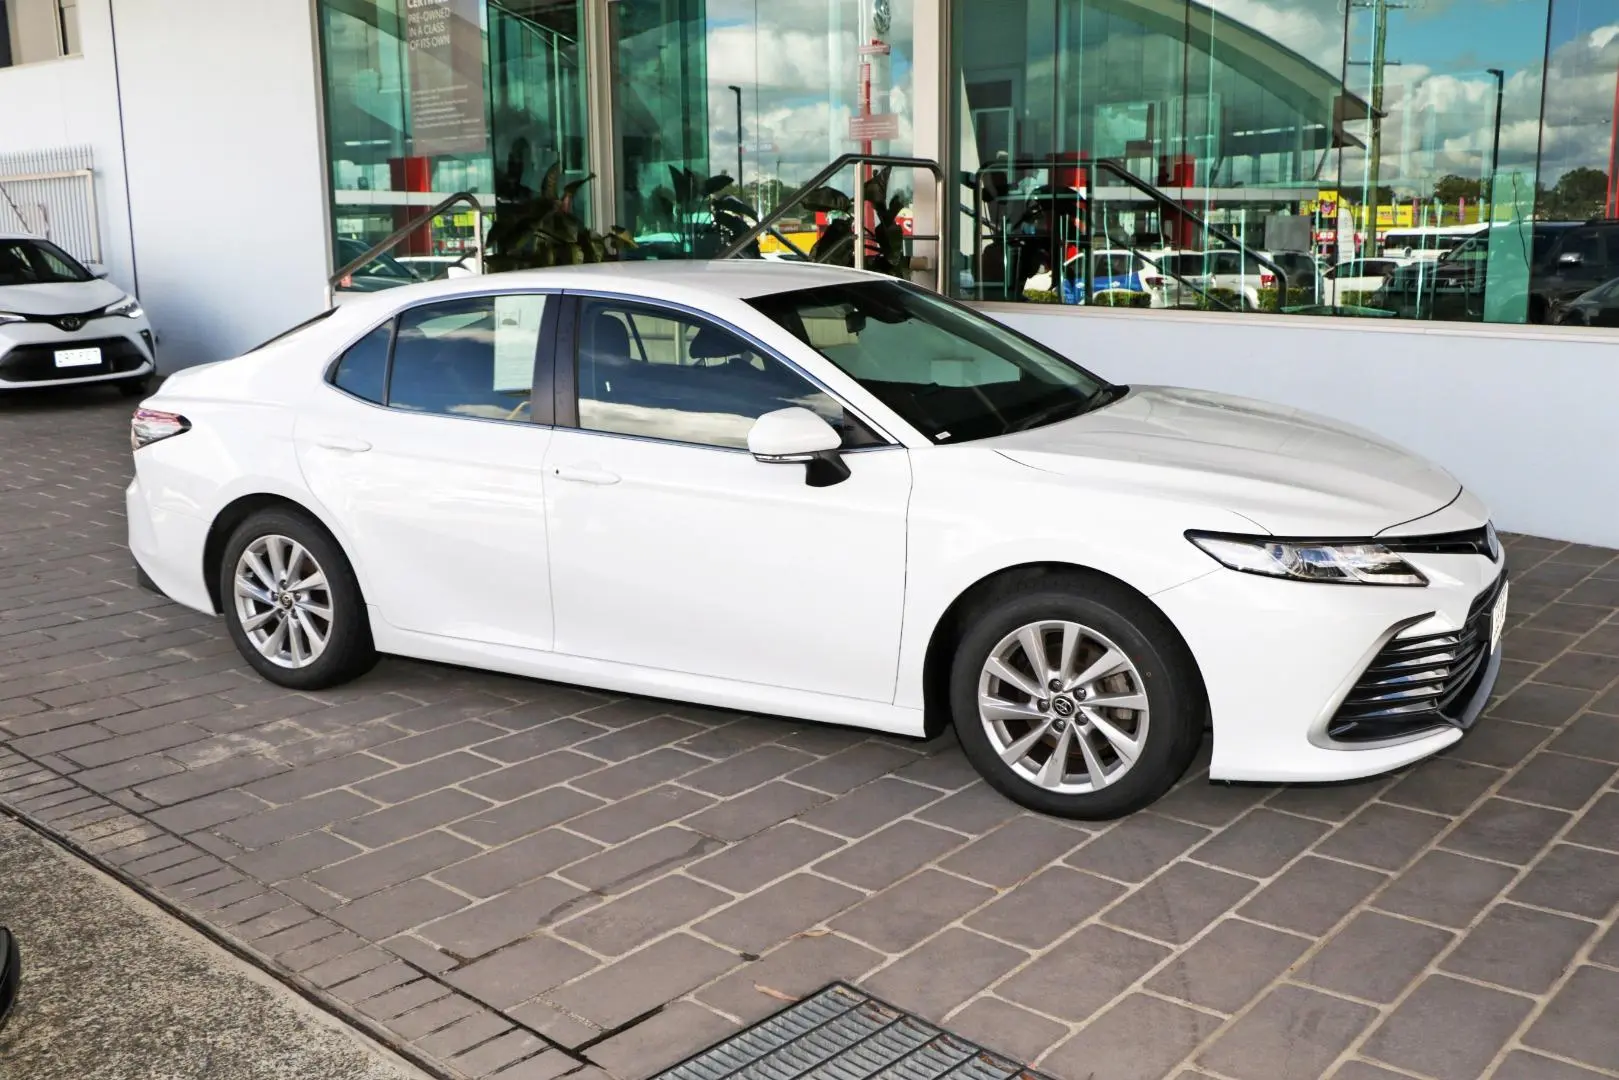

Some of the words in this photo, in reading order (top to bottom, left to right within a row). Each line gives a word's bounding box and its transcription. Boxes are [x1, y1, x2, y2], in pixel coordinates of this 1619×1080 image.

[408, 7, 450, 24] PRE-OWNED
[409, 27, 417, 37] IN
[417, 26, 423, 36] A
[424, 22, 445, 35] CLASS
[410, 39, 419, 50] OF
[420, 37, 431, 48] ITS
[432, 35, 450, 47] OWN
